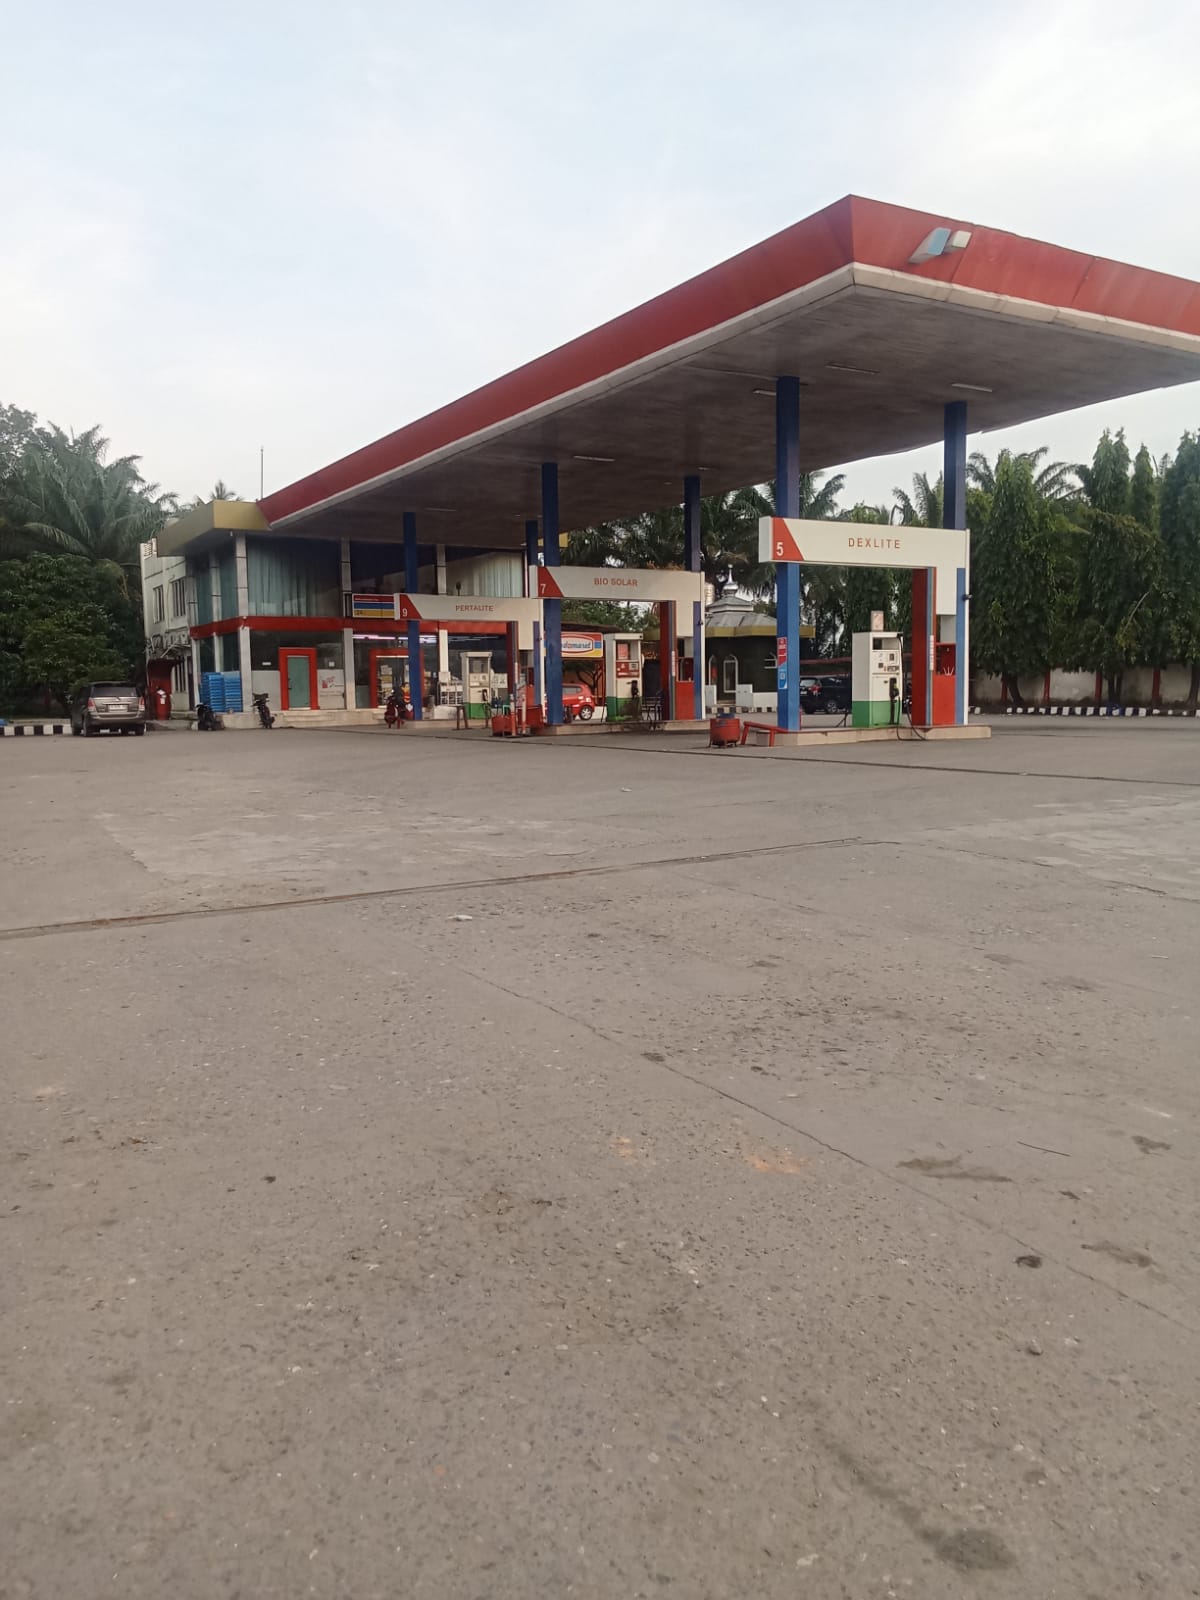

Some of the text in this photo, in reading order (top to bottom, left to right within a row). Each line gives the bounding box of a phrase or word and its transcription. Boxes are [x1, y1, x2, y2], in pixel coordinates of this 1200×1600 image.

[848, 537, 901, 549] DEXLITE
[776, 541, 784, 557] 5
[594, 577, 638, 586] BIO SOLAR
[540, 583, 547, 595] 7
[402, 607, 408, 617] 9
[455, 604, 494, 612] PERTALITE
